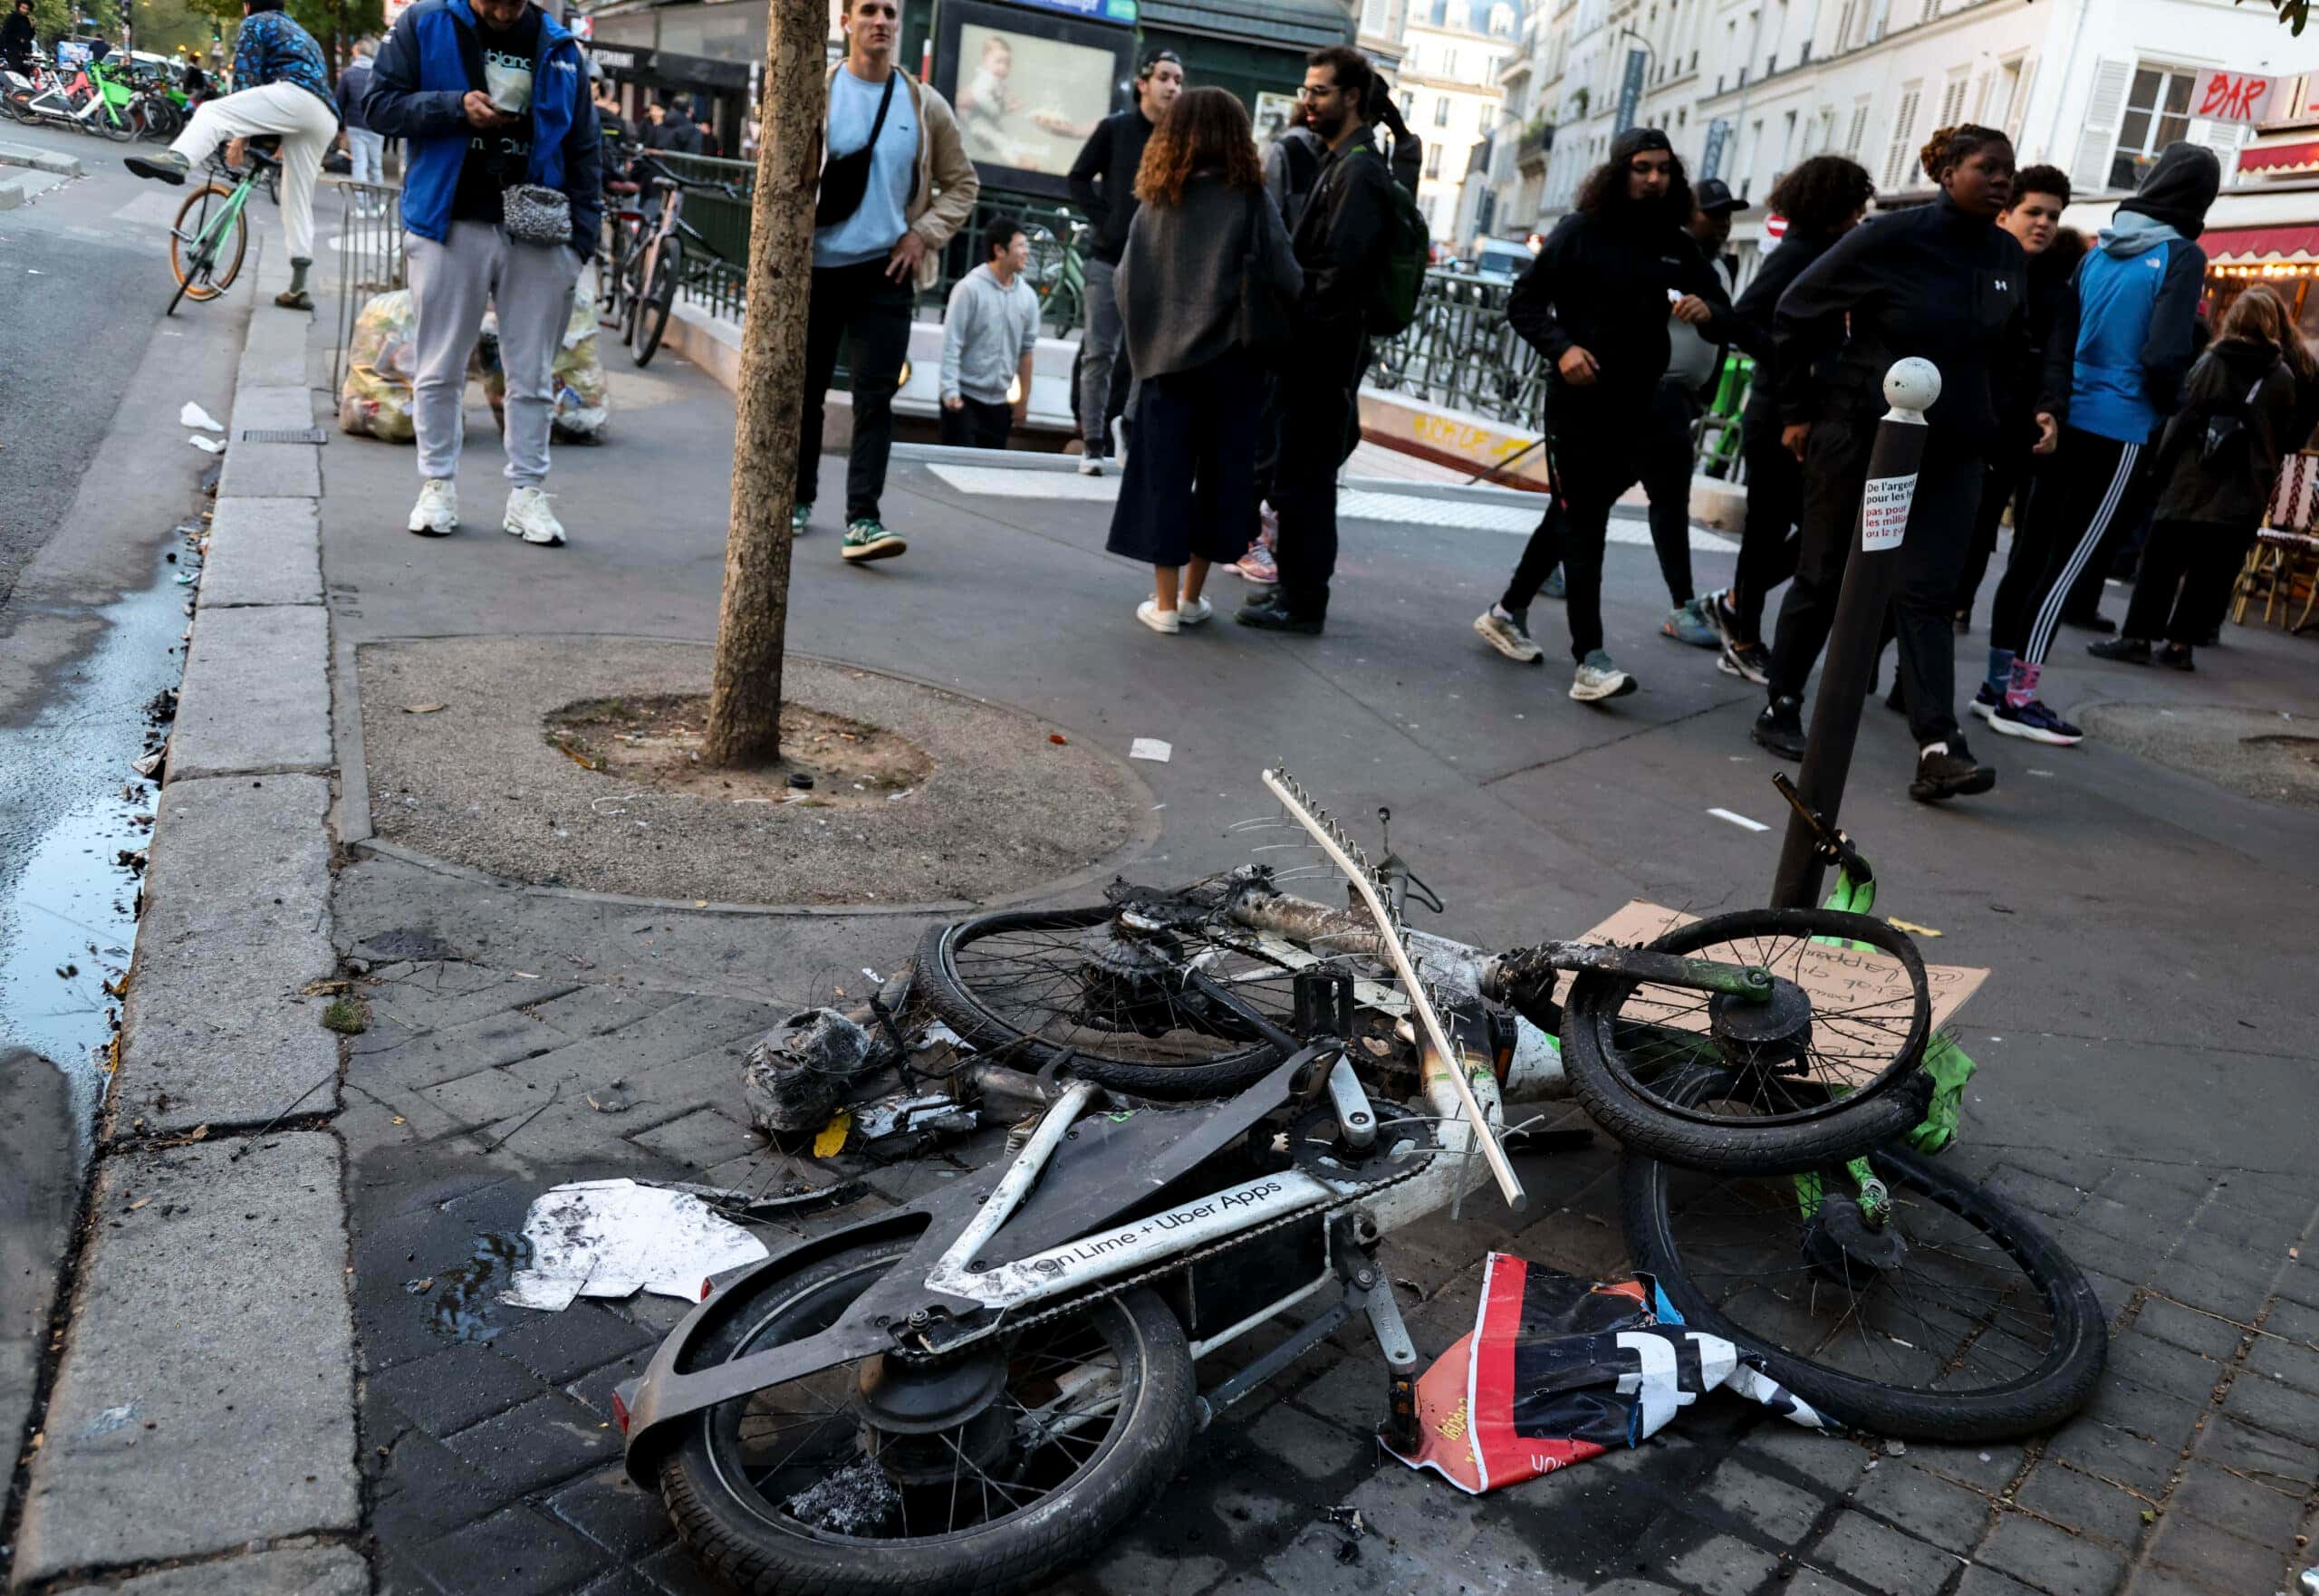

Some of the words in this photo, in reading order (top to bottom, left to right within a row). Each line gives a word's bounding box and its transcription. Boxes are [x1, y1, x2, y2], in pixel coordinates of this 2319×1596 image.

[2199, 73, 2266, 120] BAR
[1867, 484, 1880, 493] De
[1866, 495, 1890, 505] pour
[1891, 493, 1905, 502] les
[1866, 508, 1883, 517] pas
[1886, 506, 1906, 514] pour
[1866, 518, 1881, 527] les
[1074, 1233, 1139, 1259] Lime
[1155, 1203, 1216, 1228] Uber
[1220, 1180, 1283, 1210] Apps
